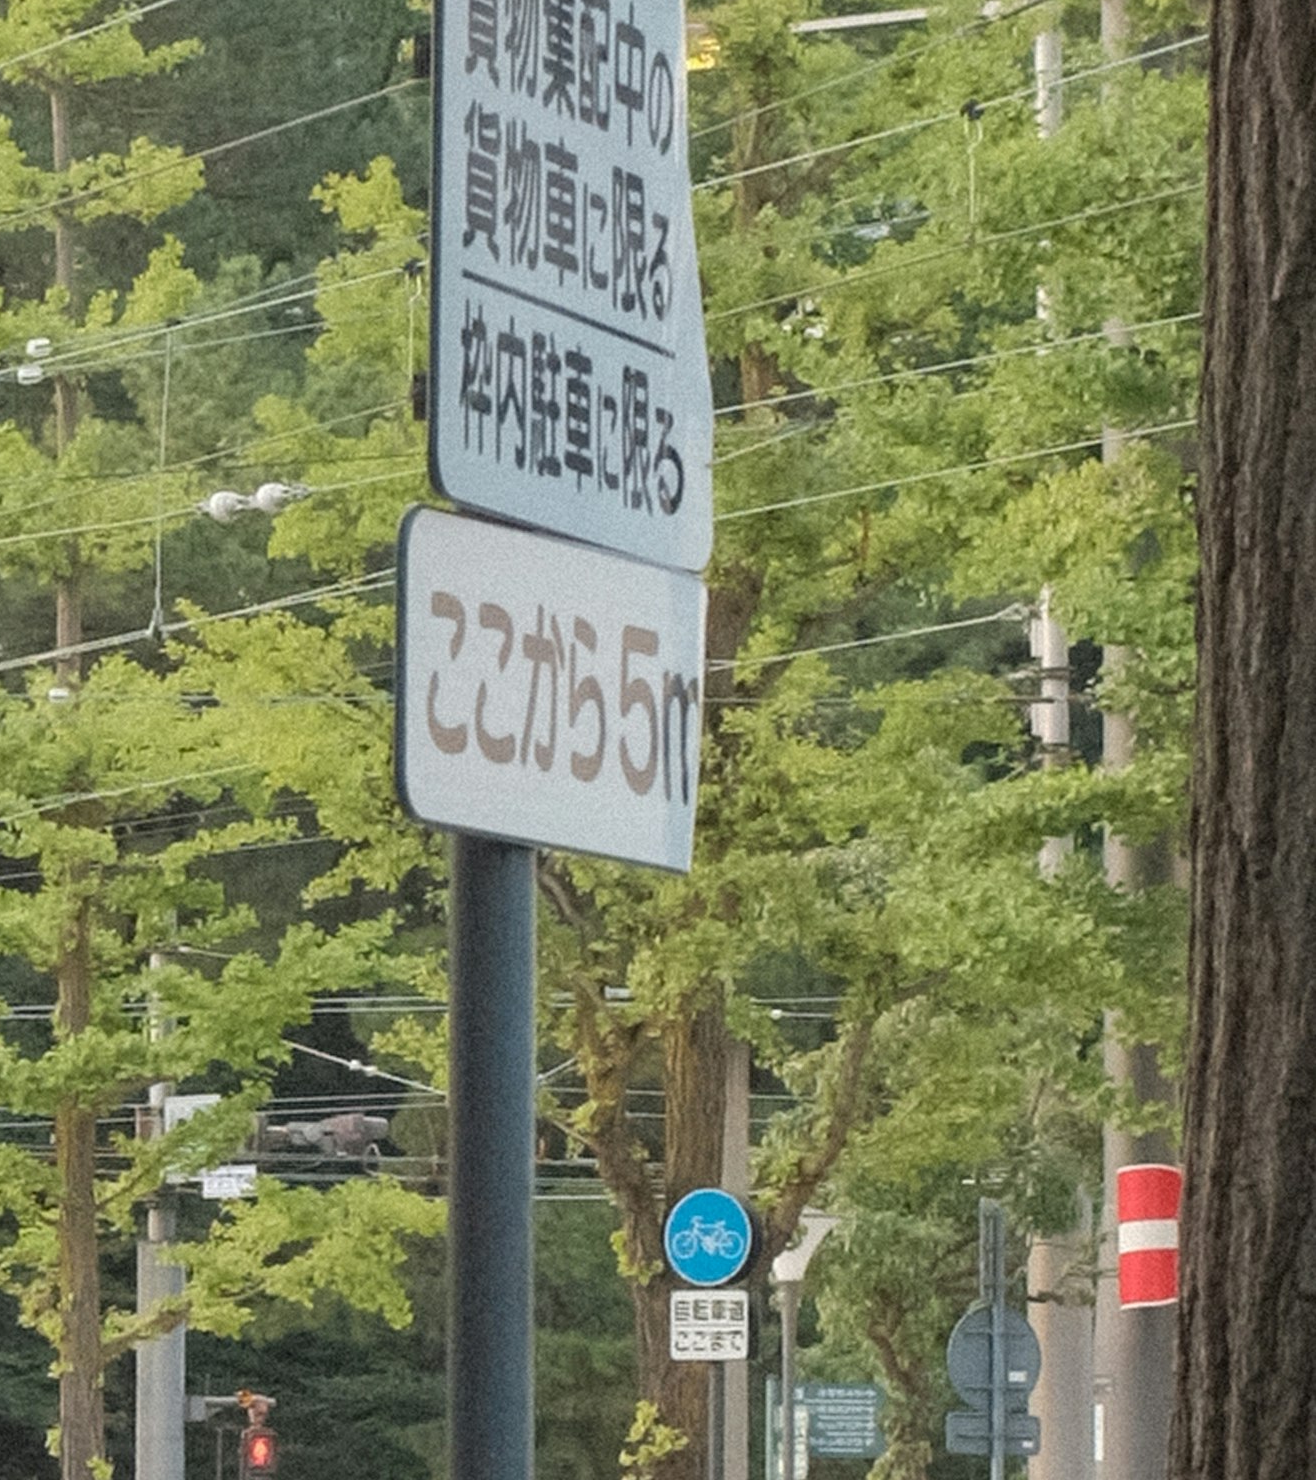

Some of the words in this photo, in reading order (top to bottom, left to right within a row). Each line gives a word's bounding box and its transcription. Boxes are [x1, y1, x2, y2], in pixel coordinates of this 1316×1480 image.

[463, 99, 672, 321] 貨物車に限る
[460, 297, 685, 517] 枠内駐車に限る
[674, 1300, 745, 1321] 自転車道
[675, 1331, 743, 1352] ここまで
